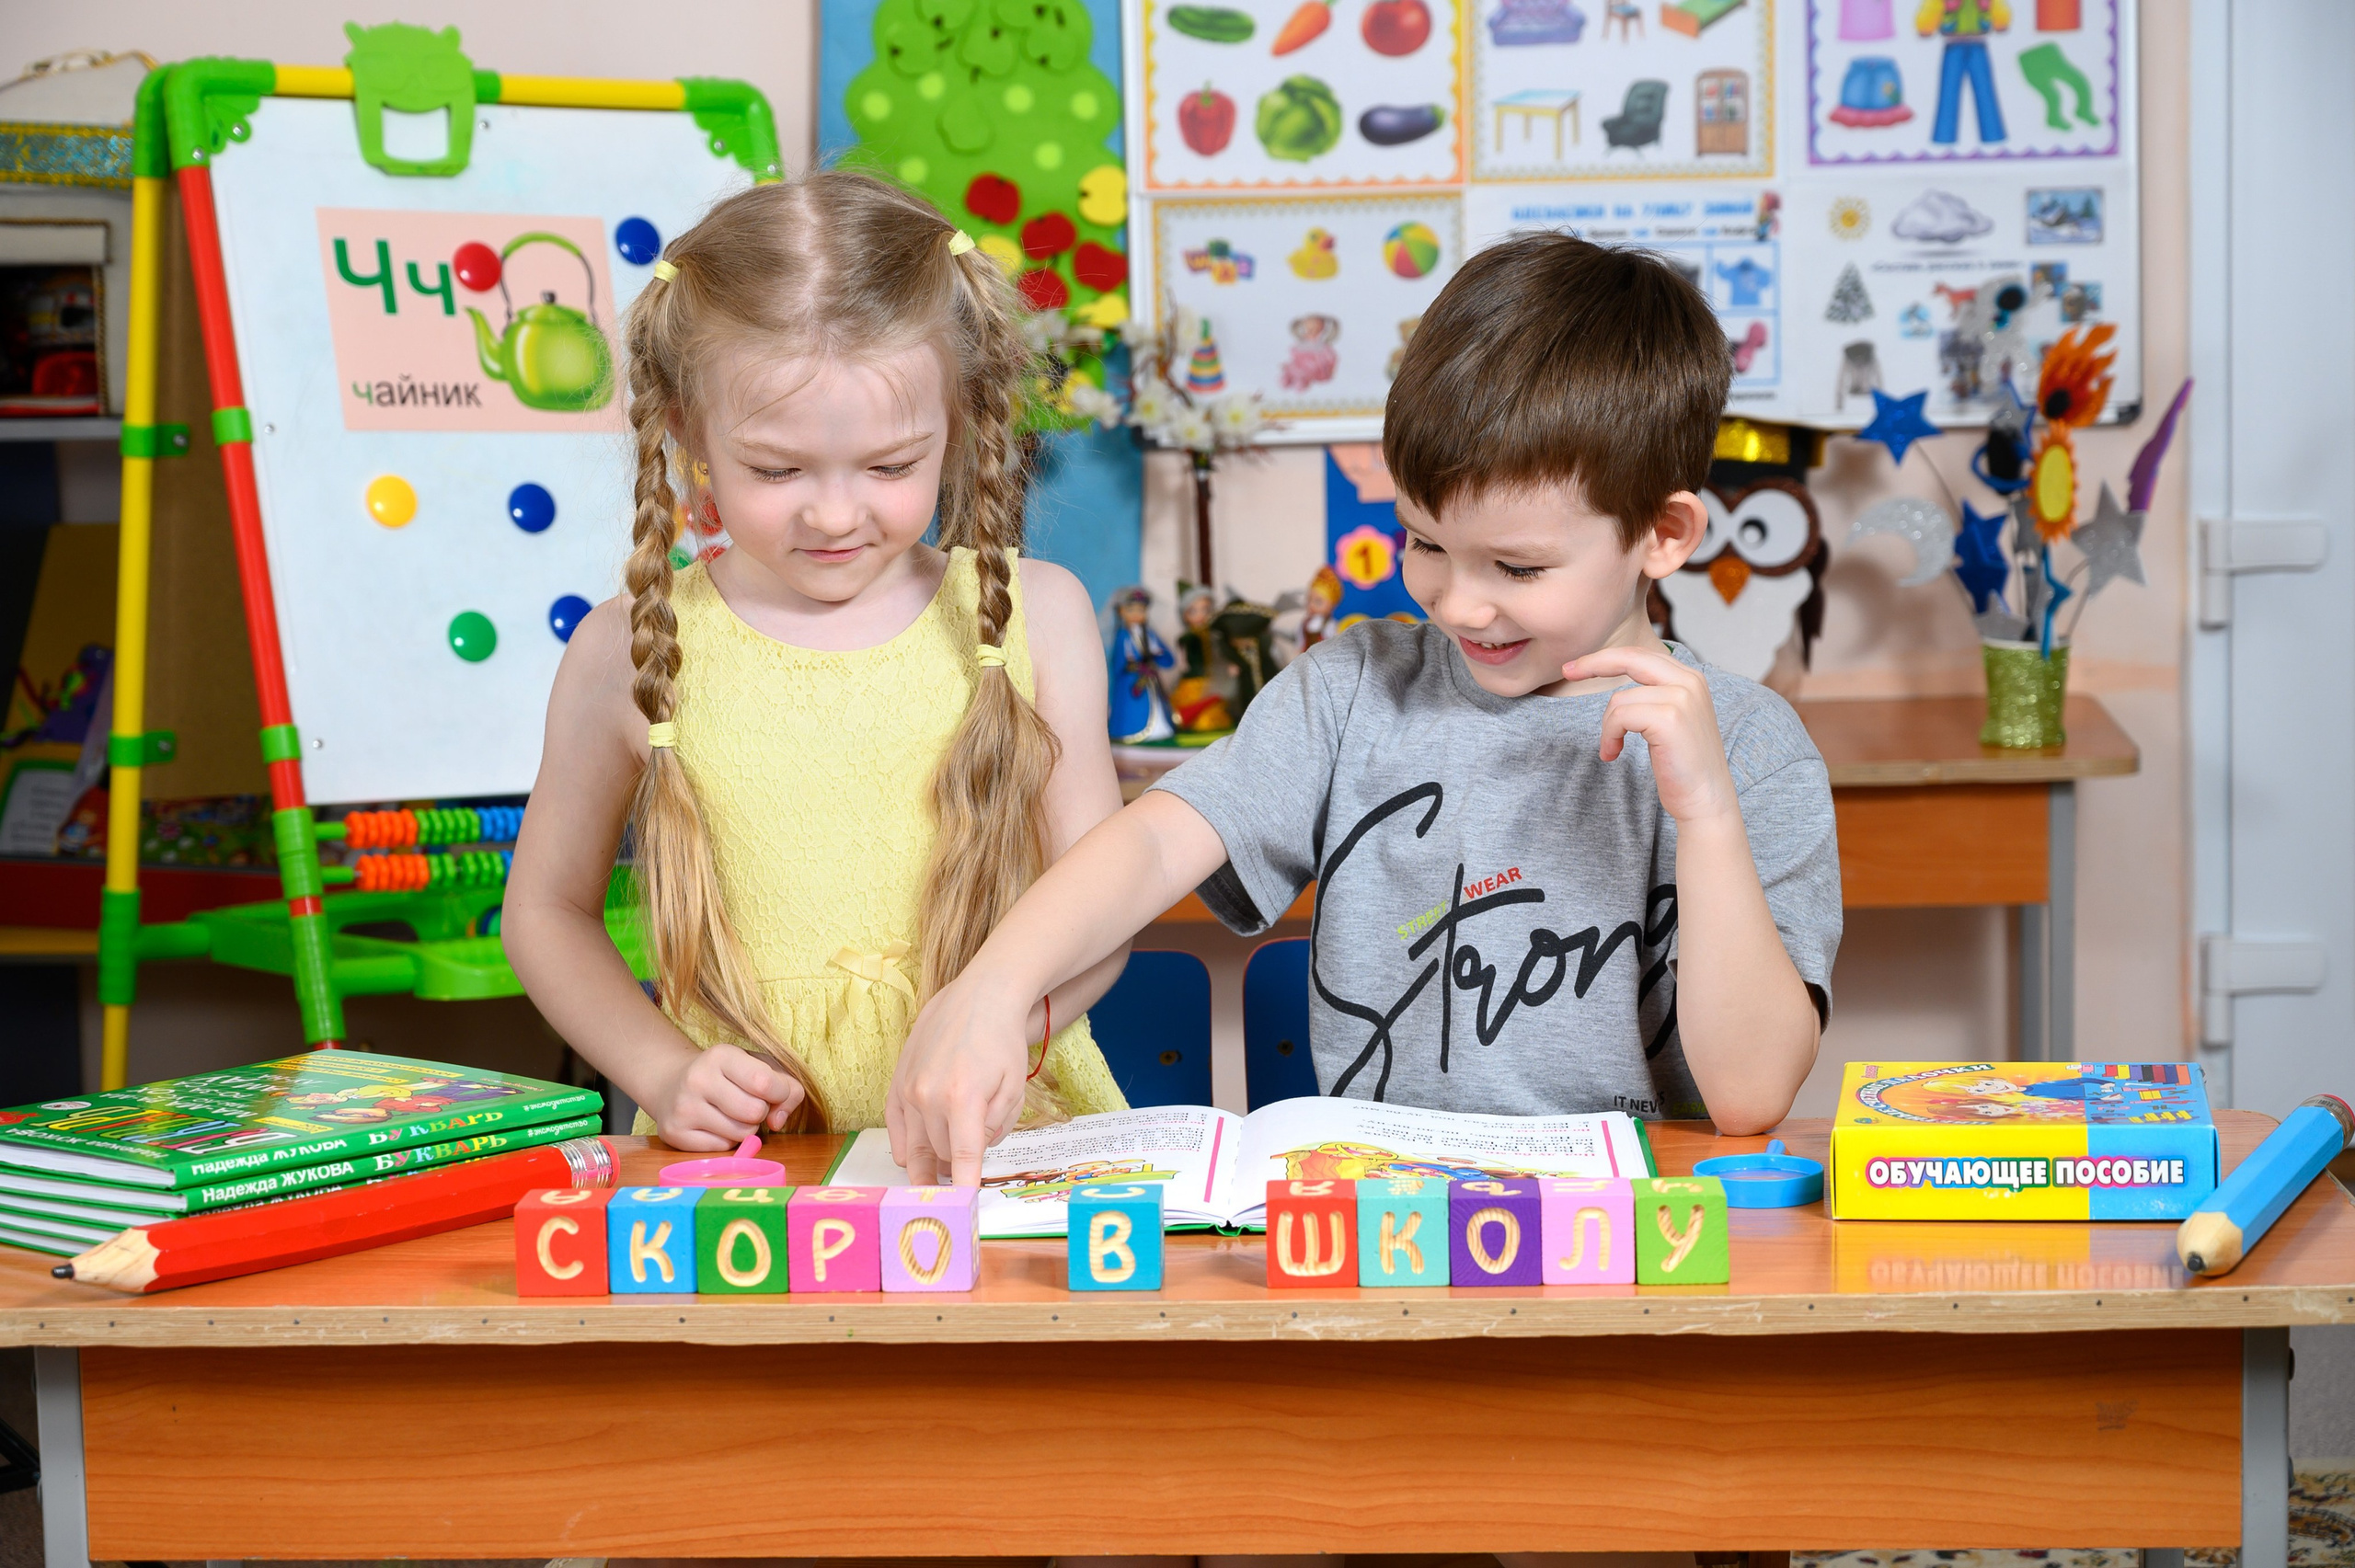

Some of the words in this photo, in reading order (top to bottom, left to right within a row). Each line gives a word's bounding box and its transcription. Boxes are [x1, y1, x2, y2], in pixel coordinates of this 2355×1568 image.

[351, 374, 482, 407] чайник
[1464, 867, 1522, 898] WEAR
[1396, 899, 1449, 940] STREET
[1614, 1095, 1627, 1108] IT
[373, 1134, 507, 1172] БУКВАРЬ
[201, 1177, 278, 1203] Надежда
[281, 1161, 354, 1187] ЖУКОВА
[1868, 1160, 2048, 1189] ОБУЧАЮЩЕЕ
[2055, 1160, 2186, 1185] ПОСОБИЕ
[537, 1215, 953, 1287] СКОРО
[1088, 1211, 1136, 1284] В
[1276, 1204, 1706, 1277] ШКОЛУ
